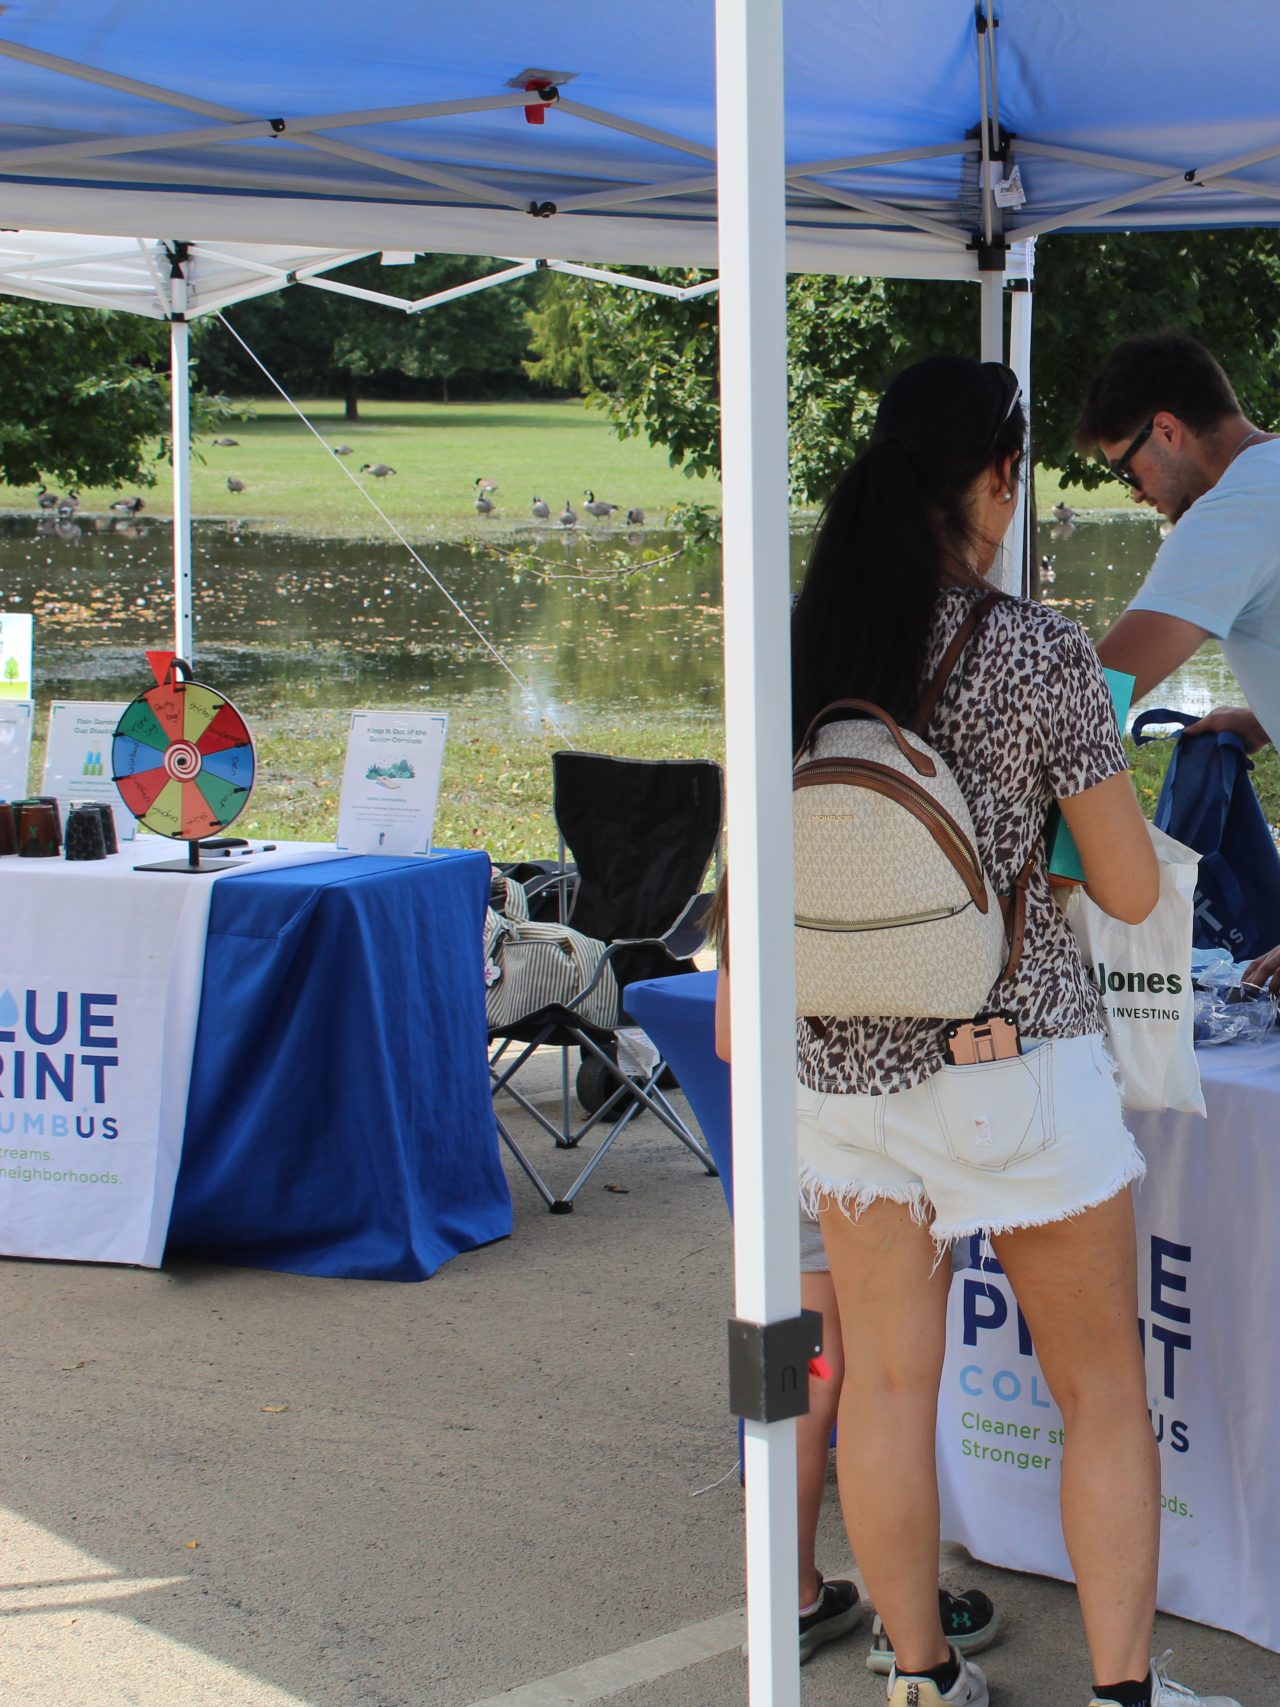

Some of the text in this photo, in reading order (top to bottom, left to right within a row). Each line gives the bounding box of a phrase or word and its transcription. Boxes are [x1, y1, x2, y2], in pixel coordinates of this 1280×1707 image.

[1098, 963, 1182, 996] Jones
[1112, 1007, 1180, 1021] INVESTING
[961, 1412, 1040, 1441] Cleaner
[961, 1439, 1052, 1470] Stronger
